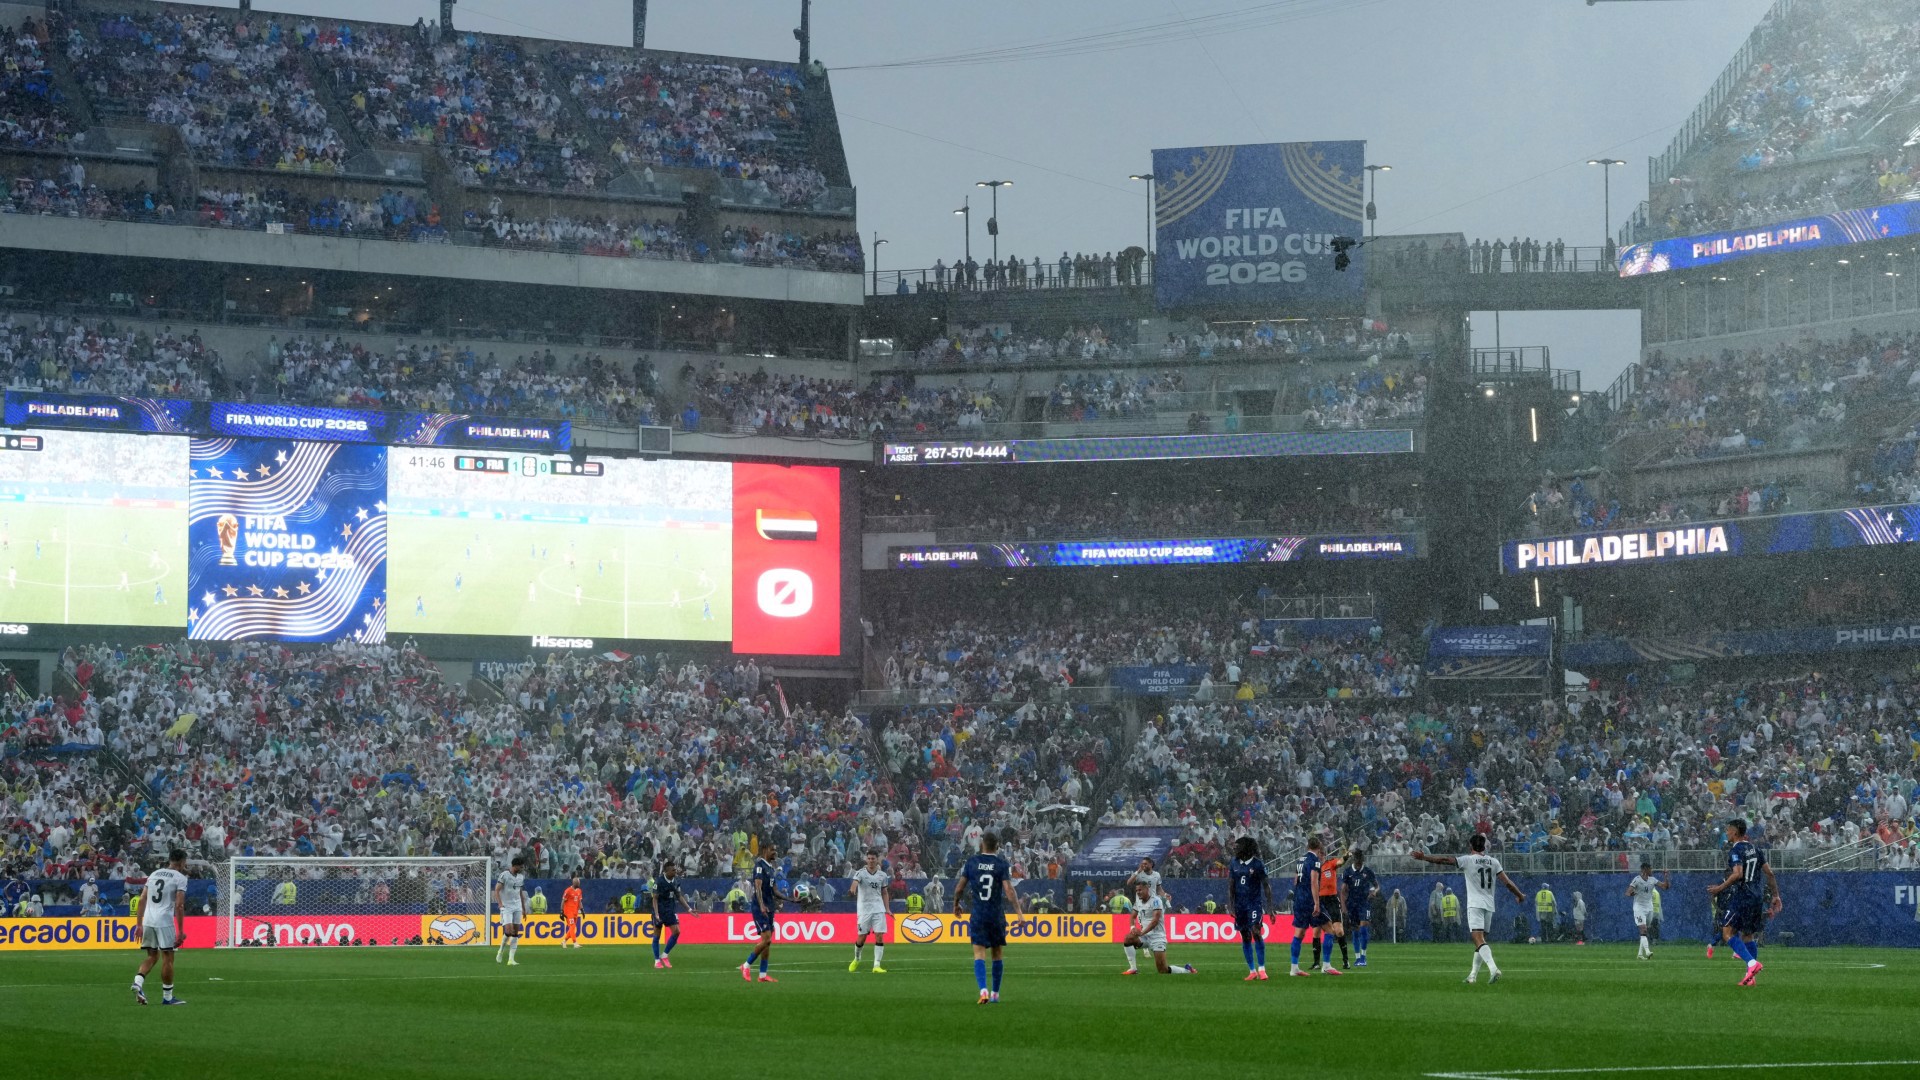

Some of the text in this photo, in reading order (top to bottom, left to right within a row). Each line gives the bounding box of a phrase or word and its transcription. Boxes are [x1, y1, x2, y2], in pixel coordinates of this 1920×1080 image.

[1225, 208, 1287, 230] FIFA
[1176, 234, 1278, 260] WORLD
[1693, 224, 1821, 259] PHILADELPHIA
[1206, 261, 1308, 286] 2026
[28, 404, 120, 418] PHILADELPHIA
[226, 413, 369, 431] FIFA WORLD CUP 2026
[468, 426, 550, 439] PHILADELPHIA
[890, 454, 918, 462] ASSIST
[895, 446, 915, 454] TEXT
[925, 446, 1008, 459] 267-570-4444
[409, 456, 446, 469] 41:46
[245, 515, 287, 531] FIFA
[245, 532, 316, 550] WORLD
[1320, 543, 1402, 554] PHILADELPHIA
[1518, 526, 1728, 569] PHILADELPHIA
[244, 551, 355, 569] CUP 2026
[900, 551, 978, 562] PHILADELPHIA
[1082, 546, 1213, 559] FIFA WORLD CUP 2026
[532, 635, 593, 648] Hisense
[480, 662, 505, 672] FIA
[1153, 670, 1171, 678] FIFA
[978, 863, 995, 871] DIGNE
[1745, 858, 1757, 882] 17
[1240, 875, 1246, 885] 6
[1478, 867, 1492, 889] 11
[152, 879, 165, 904] 3
[979, 874, 994, 901] 3
[1895, 886, 1920, 904] FI
[1252, 910, 1257, 919] 6
[96, 919, 138, 943] libr
[235, 918, 355, 944] Lenovo
[603, 916, 655, 939] libre
[951, 916, 1106, 938] mado libre
[1170, 916, 1269, 940] Lenoo
